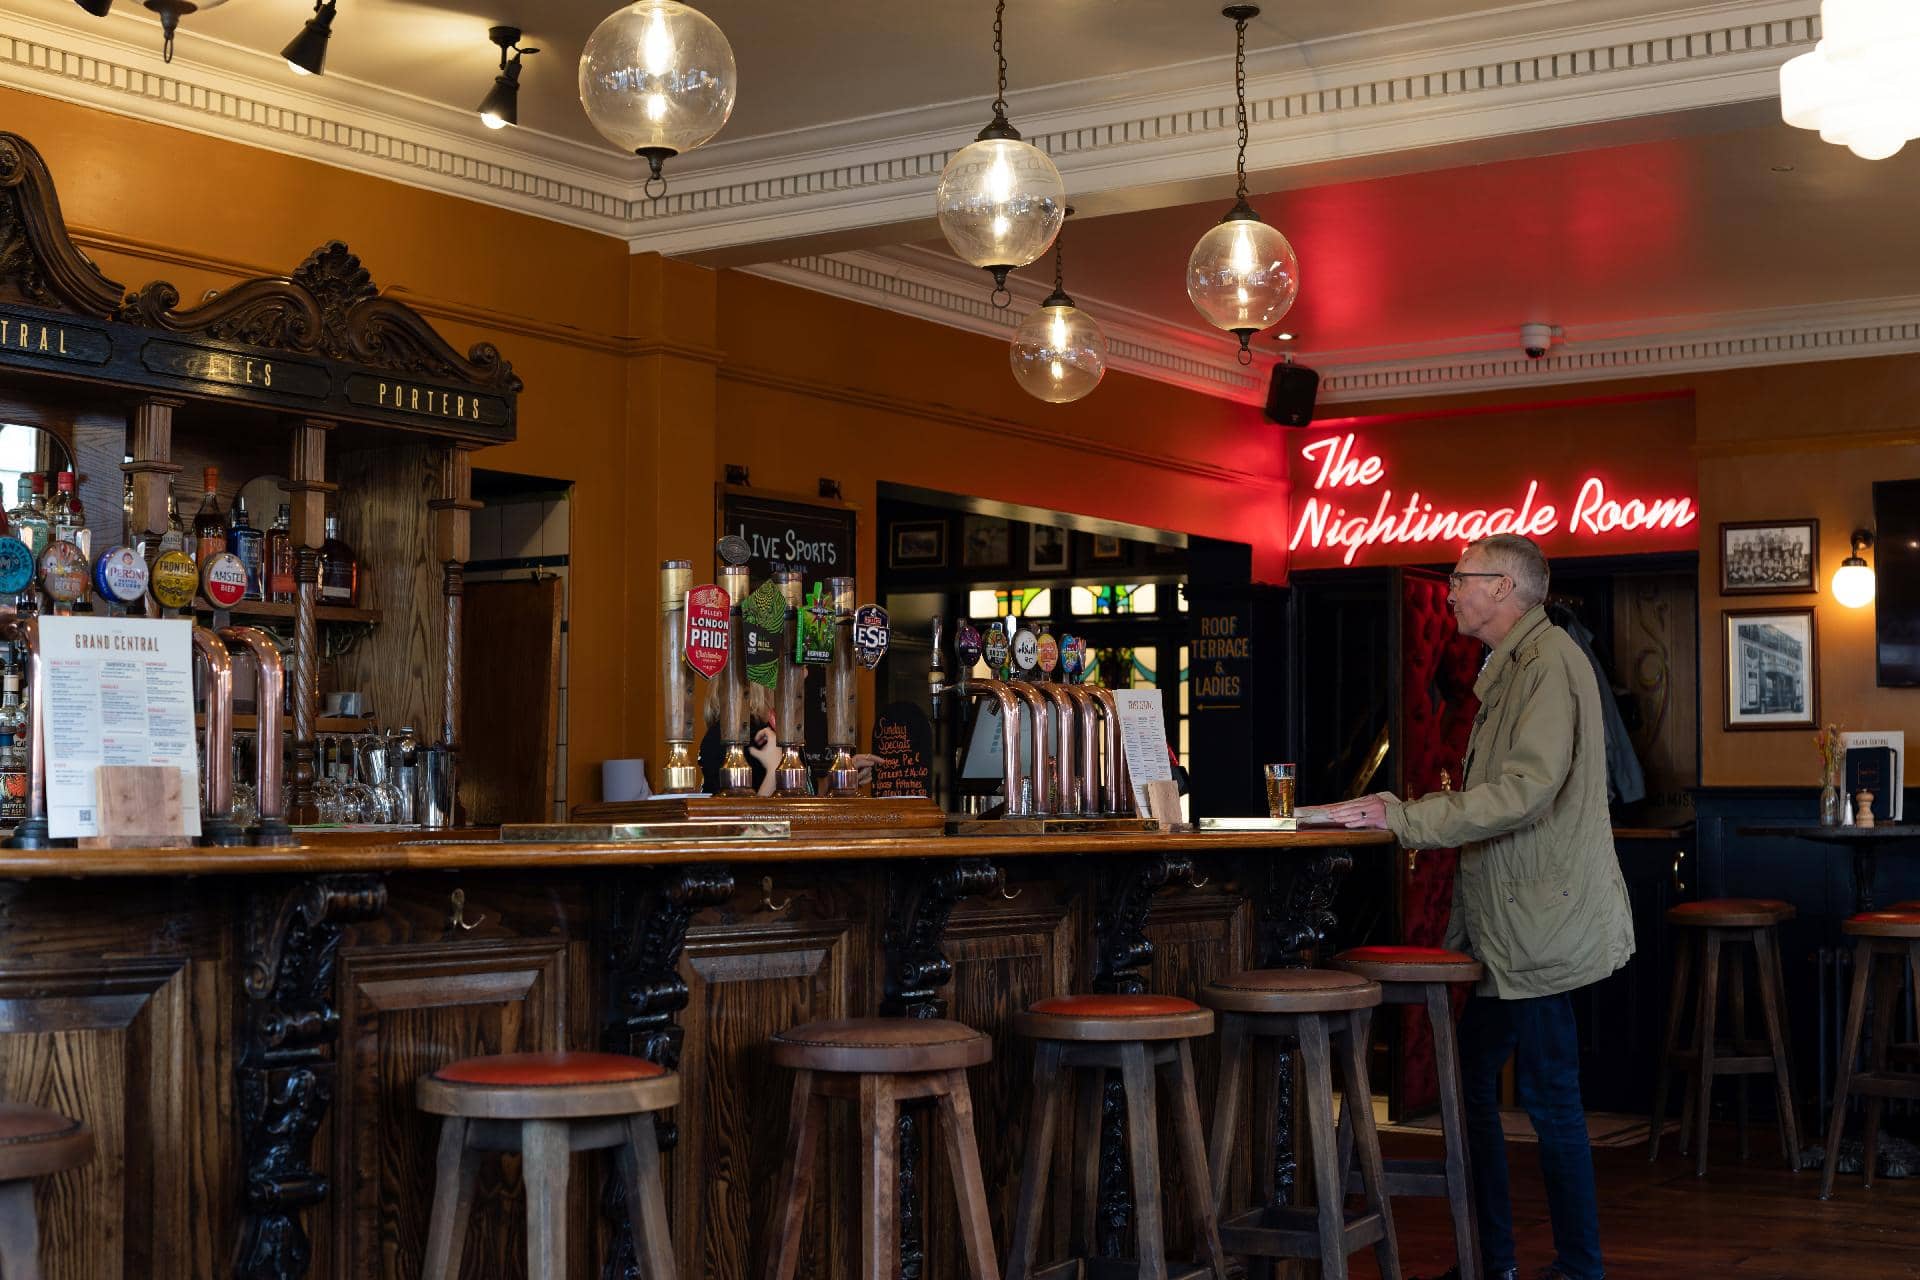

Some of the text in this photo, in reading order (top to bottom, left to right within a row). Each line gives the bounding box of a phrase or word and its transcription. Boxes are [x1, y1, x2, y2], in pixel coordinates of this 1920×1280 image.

[379, 383, 479, 419] PORTERS
[1302, 433, 1384, 490] The
[1289, 477, 1696, 566] Nightingale Room
[785, 529, 837, 566] SPORTS
[213, 571, 245, 583] AMSTEL
[220, 584, 236, 593] BIER
[691, 617, 729, 630] LONDON
[1201, 616, 1238, 636] ROOF
[75, 634, 159, 652] GRAND CENTRAL
[690, 629, 728, 650] PRIDE
[858, 627, 887, 648] ESB
[1191, 637, 1249, 658] TERRACE
[1195, 676, 1240, 696] LADIES
